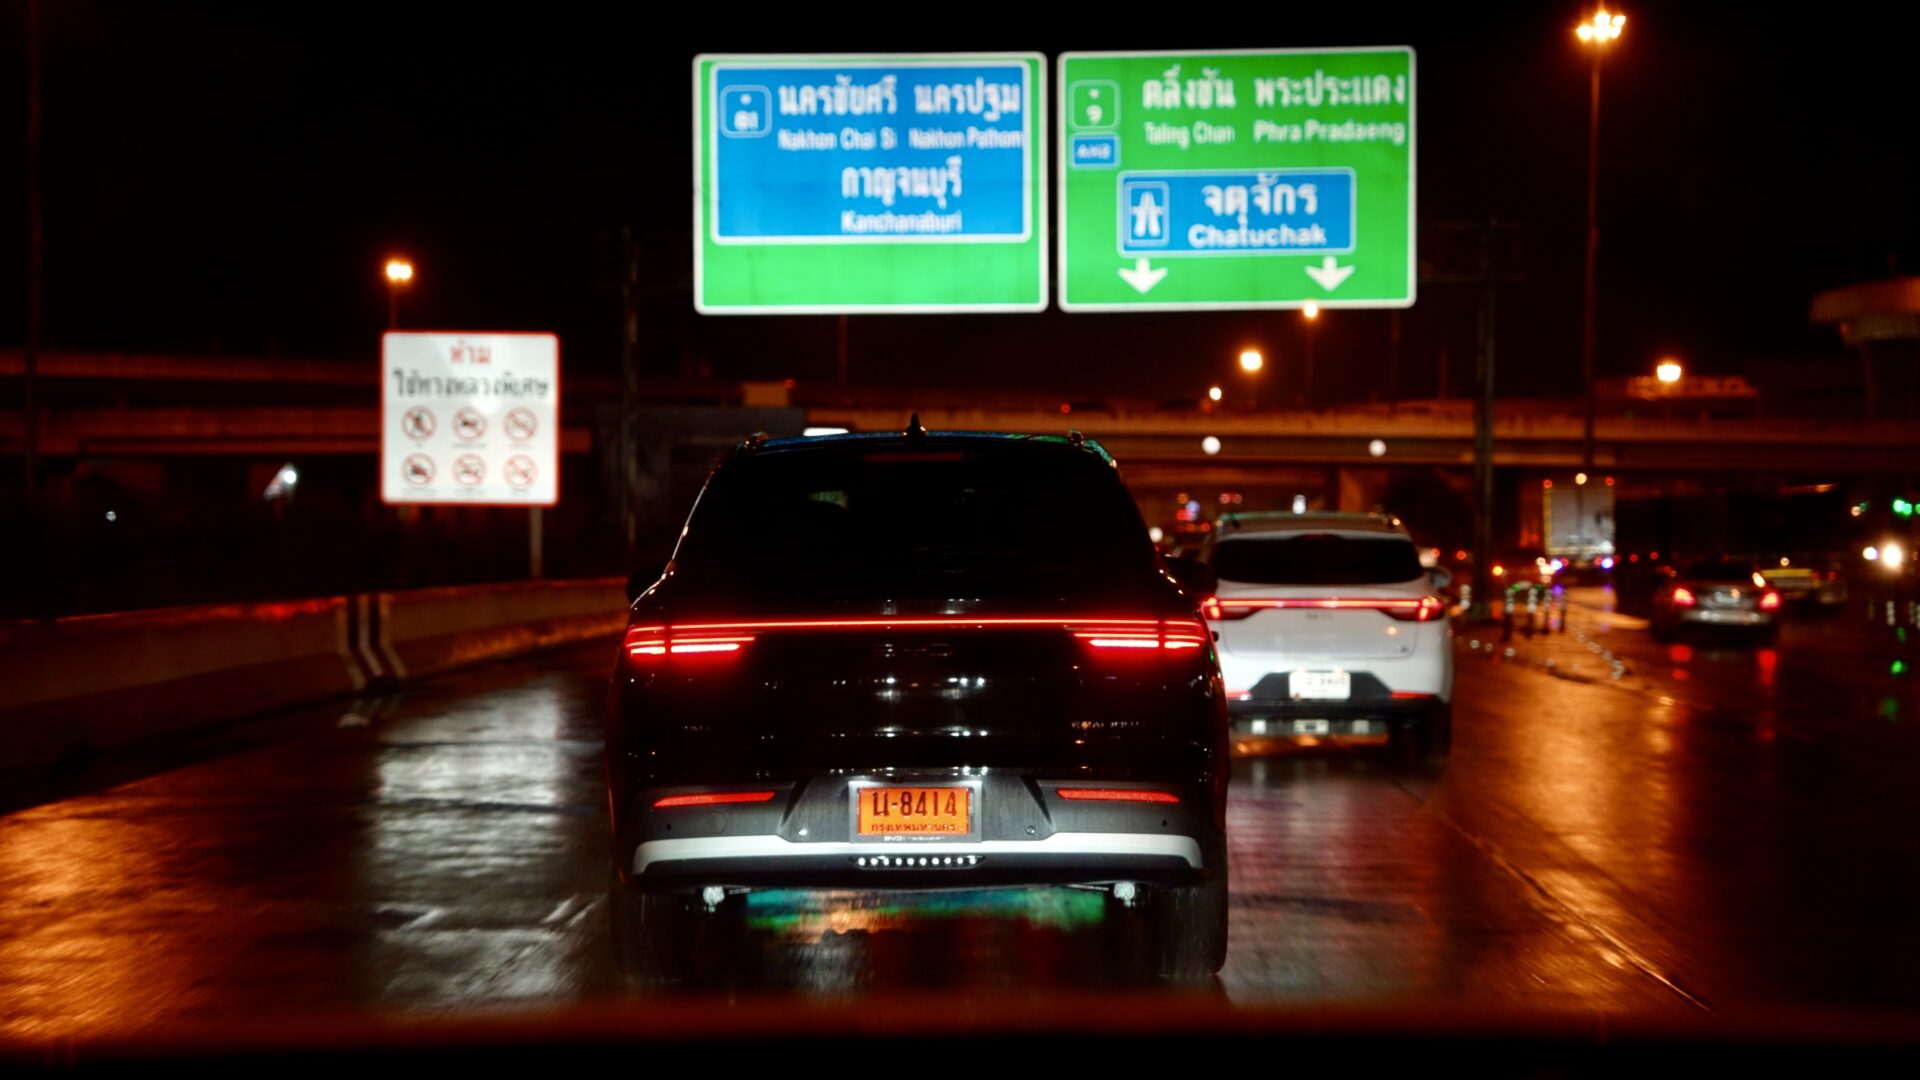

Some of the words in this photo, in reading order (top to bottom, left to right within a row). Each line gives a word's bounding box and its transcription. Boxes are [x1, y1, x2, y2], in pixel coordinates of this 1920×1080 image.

[914, 77, 1022, 122] นครปฐม
[1253, 70, 1406, 107] พระประแดง
[1086, 104, 1103, 125] 9
[778, 129, 837, 149] Nakhon
[840, 127, 876, 149] Chai
[880, 127, 898, 149] Si
[909, 129, 965, 148] Nakhon
[967, 127, 1024, 148] Pathom
[1145, 122, 1189, 149] Taling
[1193, 121, 1235, 144] Chan
[1254, 119, 1302, 143] Phra
[1304, 119, 1405, 146] Pradaeng
[841, 155, 962, 208] กาญจนบุรี
[1202, 172, 1318, 226] จตุจักร
[841, 211, 962, 234] Kanchanaburi
[1187, 224, 1327, 248] Chatuchak
